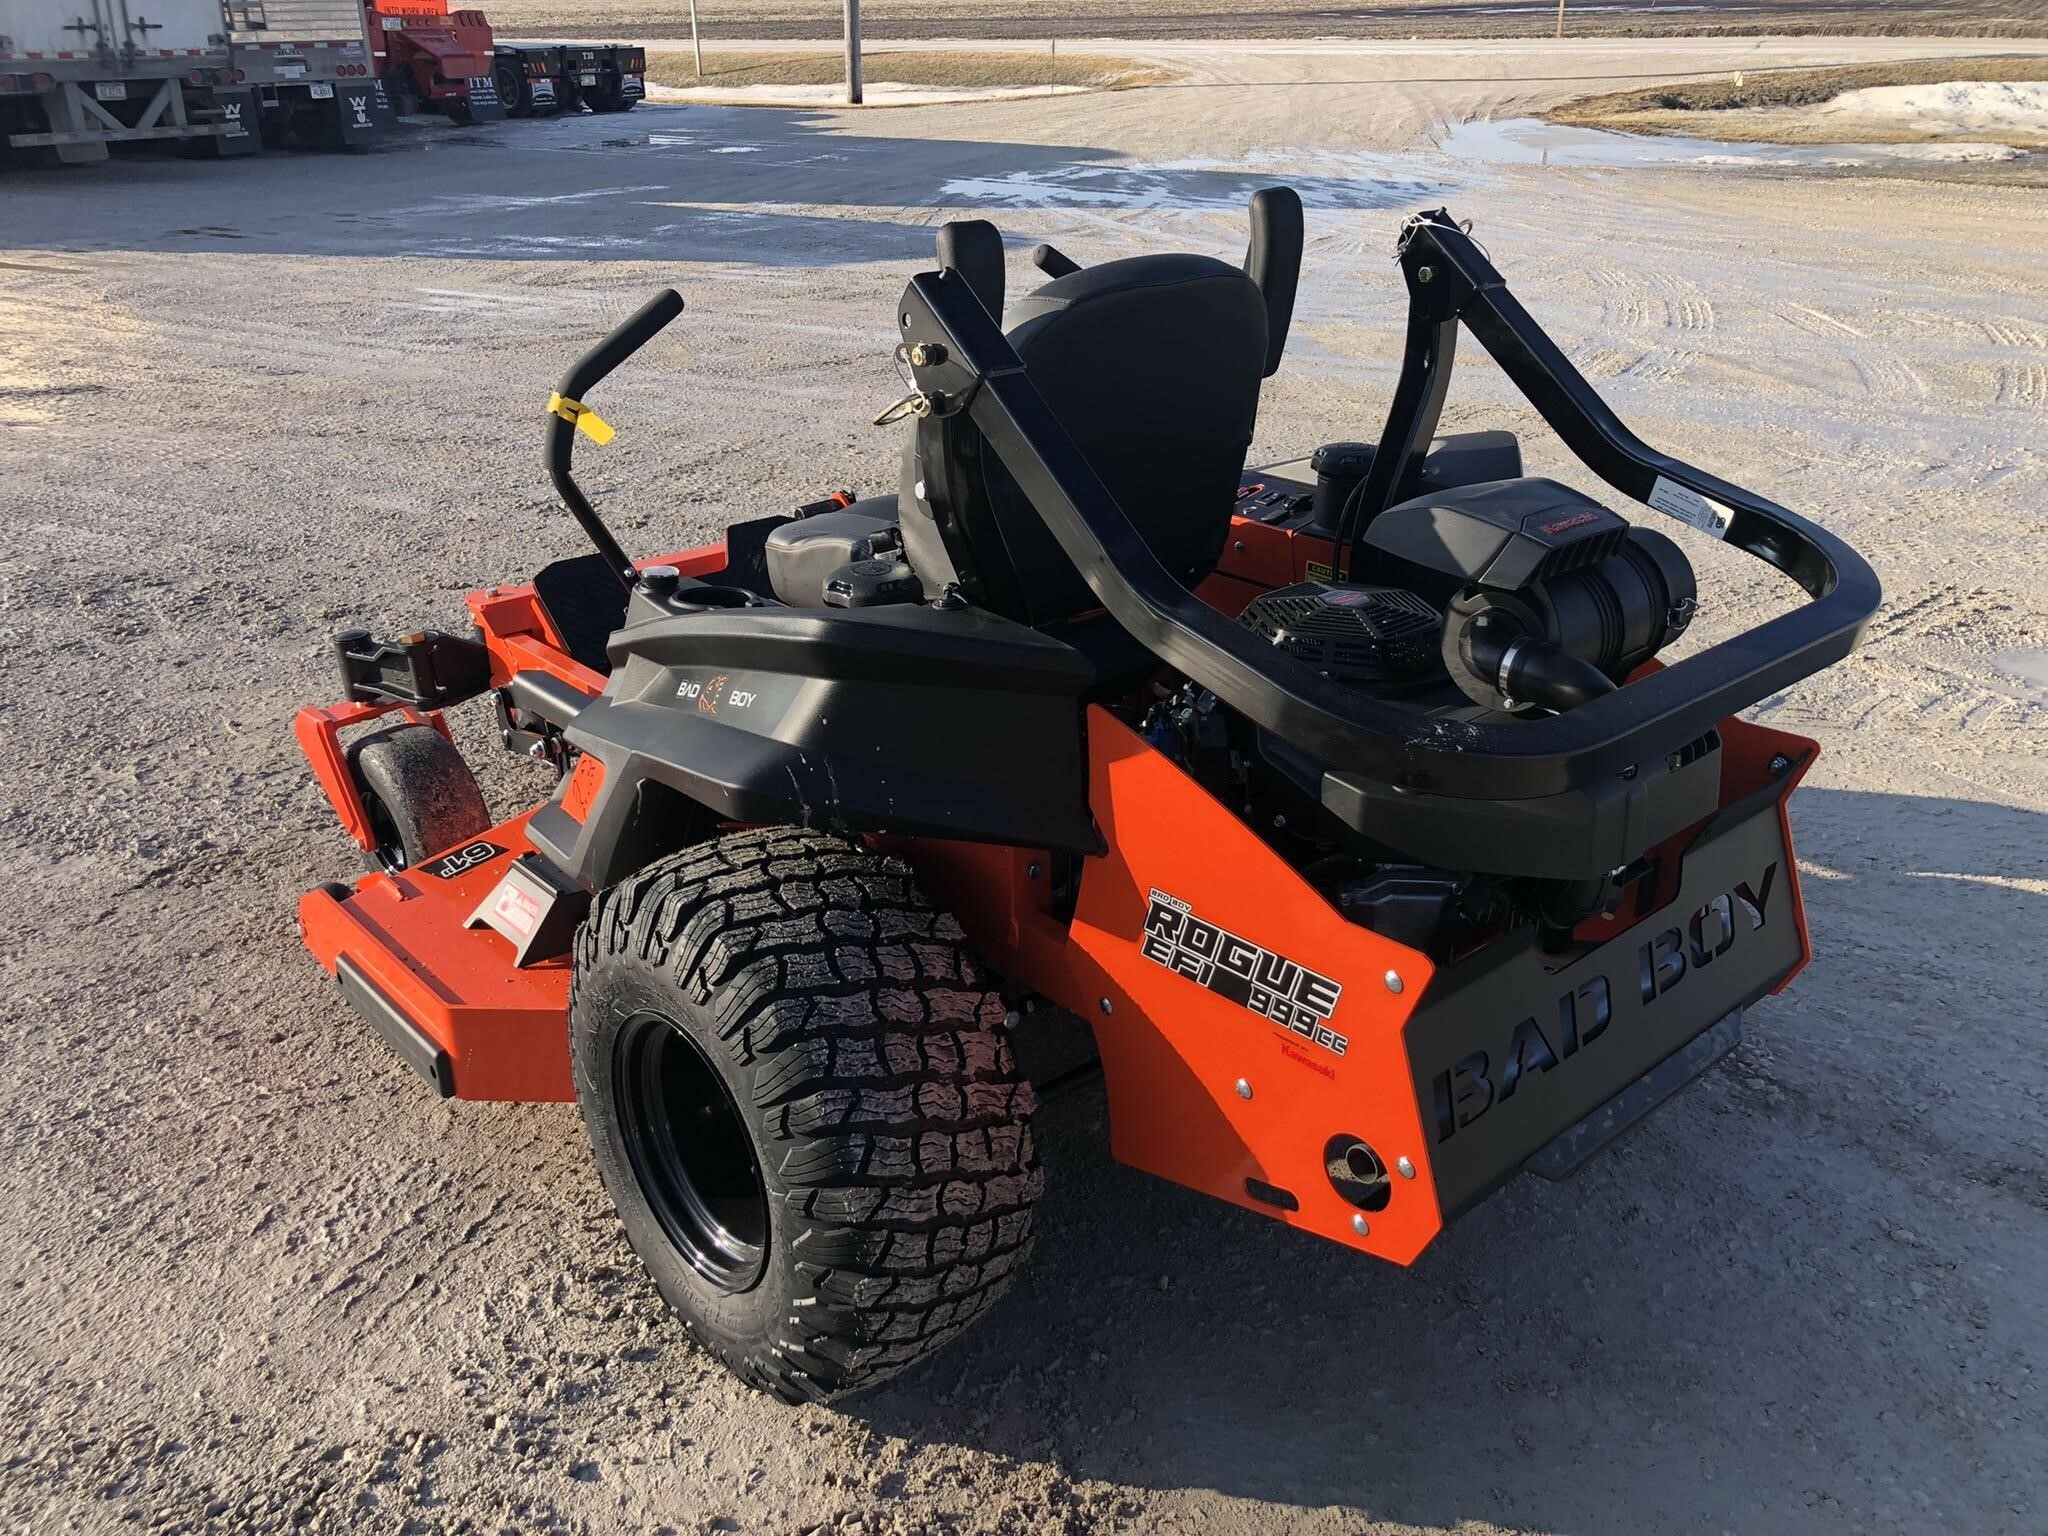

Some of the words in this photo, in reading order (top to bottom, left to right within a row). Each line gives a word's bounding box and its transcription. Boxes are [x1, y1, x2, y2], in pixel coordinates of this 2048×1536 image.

[384, 6, 399, 14] INTO
[402, 7, 419, 15] WORK
[423, 8, 439, 16] AREA
[469, 77, 493, 88] ITM
[676, 681, 700, 699] BAD
[729, 690, 757, 708] BOY
[1150, 888, 1169, 901] BAD
[1170, 898, 1191, 912] BOY
[1141, 932, 1216, 986] EFI
[1144, 899, 1343, 1019] ROGUE
[1432, 974, 1612, 1144] BAD
[1638, 861, 1777, 1006] BOY
[1281, 1042, 1335, 1080] Kawasaki
